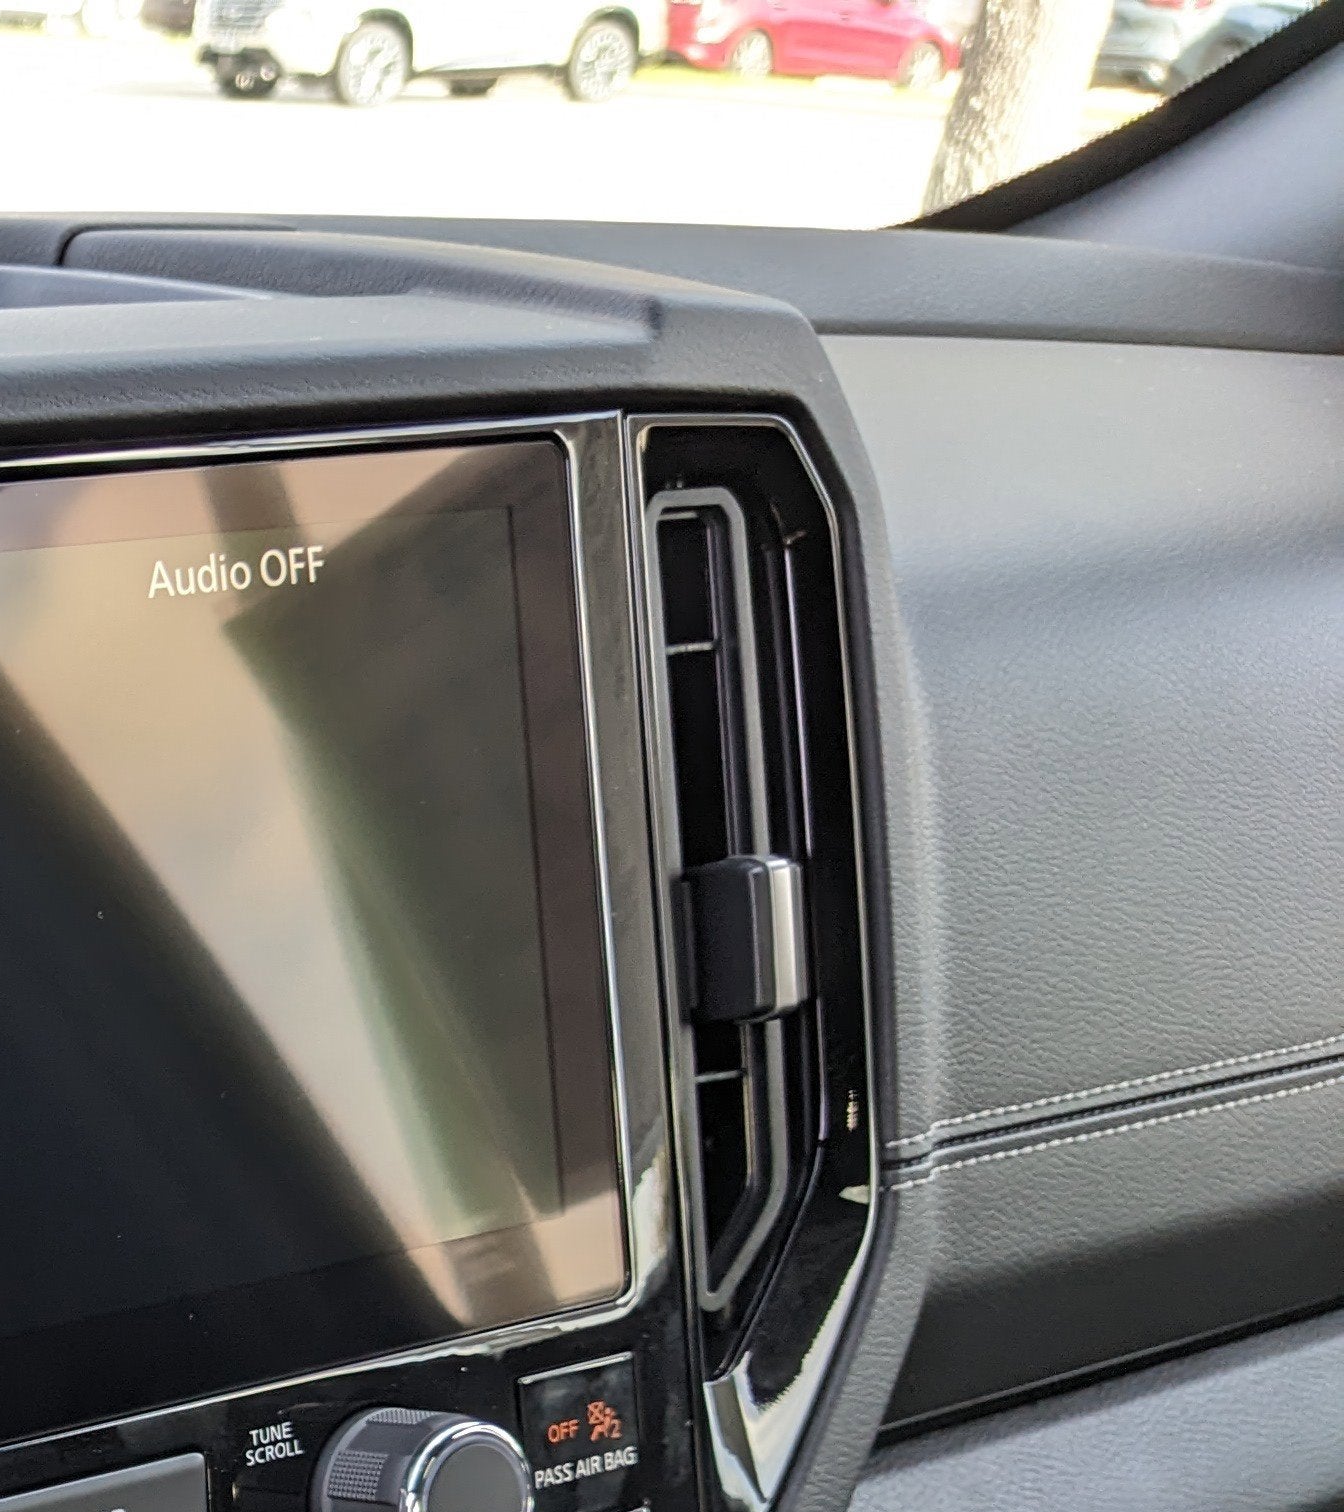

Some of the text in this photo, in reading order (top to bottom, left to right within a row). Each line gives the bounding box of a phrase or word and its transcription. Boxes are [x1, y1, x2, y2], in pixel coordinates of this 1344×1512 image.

[148, 545, 326, 600] Audio OFF
[248, 1422, 293, 1447] TUNE
[547, 1419, 579, 1443] OFF
[245, 1432, 304, 1466] SCROLL
[534, 1445, 640, 1490] PASS AIR BAG
